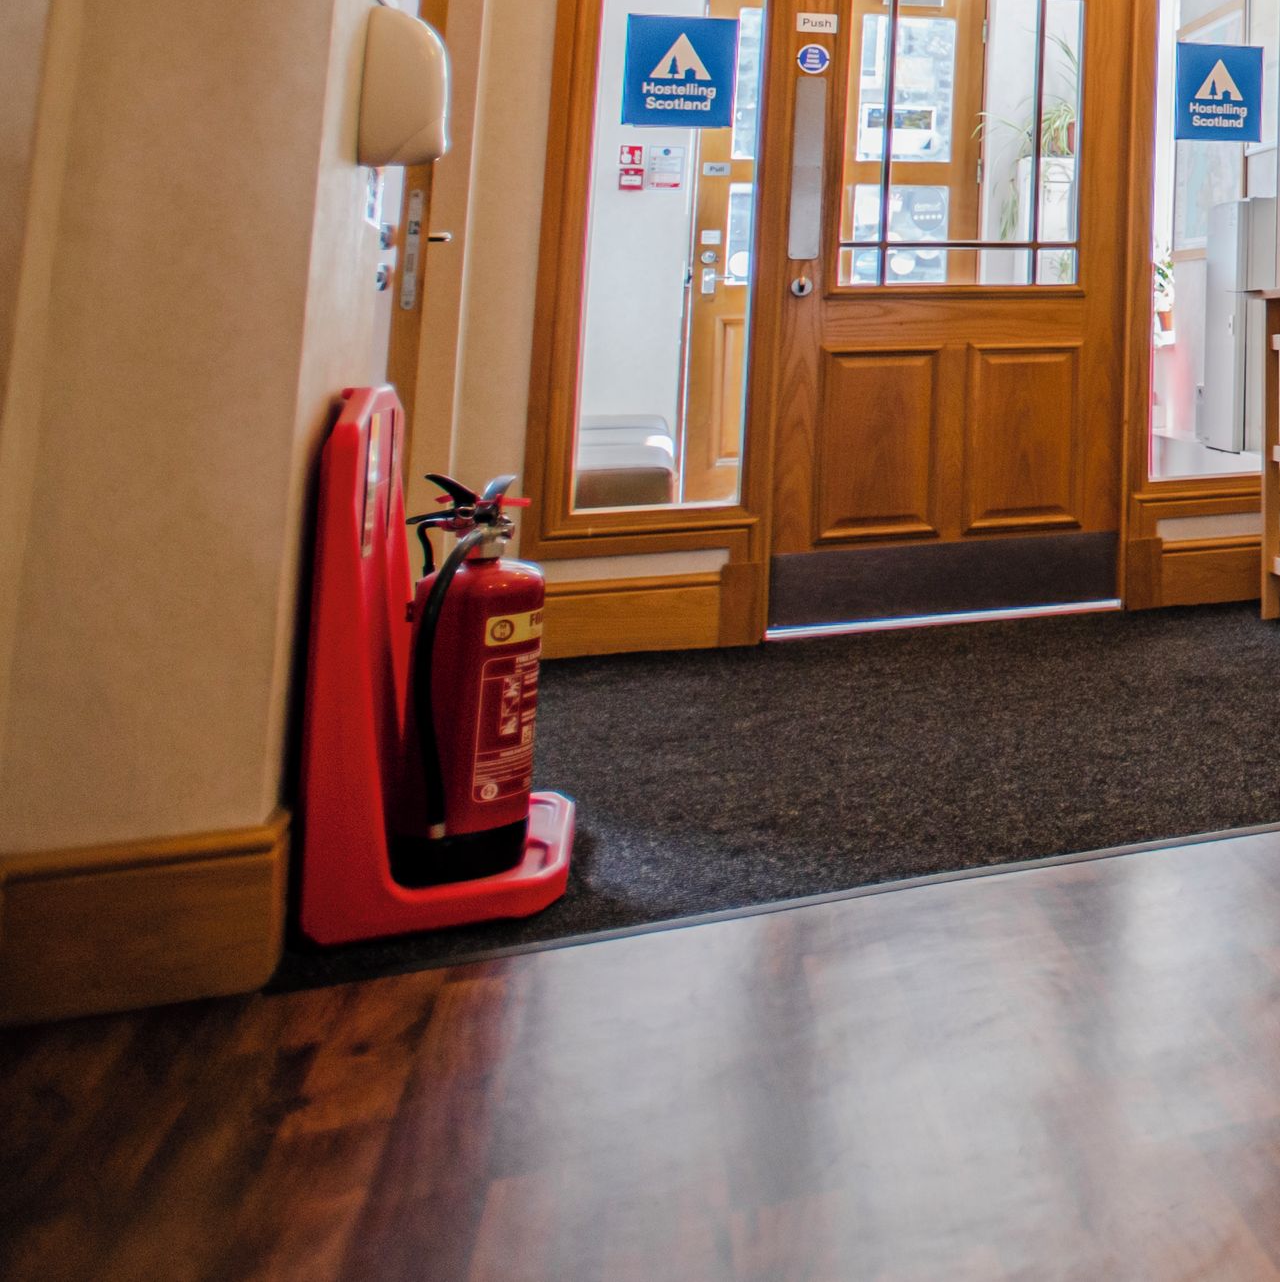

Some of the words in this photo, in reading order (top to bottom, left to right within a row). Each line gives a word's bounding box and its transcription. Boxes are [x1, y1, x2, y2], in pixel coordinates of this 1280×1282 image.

[802, 18, 832, 28] Push
[642, 81, 716, 98] Hostelling
[645, 96, 711, 111] Scotland
[1190, 102, 1247, 118] Hostelling
[1192, 116, 1244, 128] Scotland
